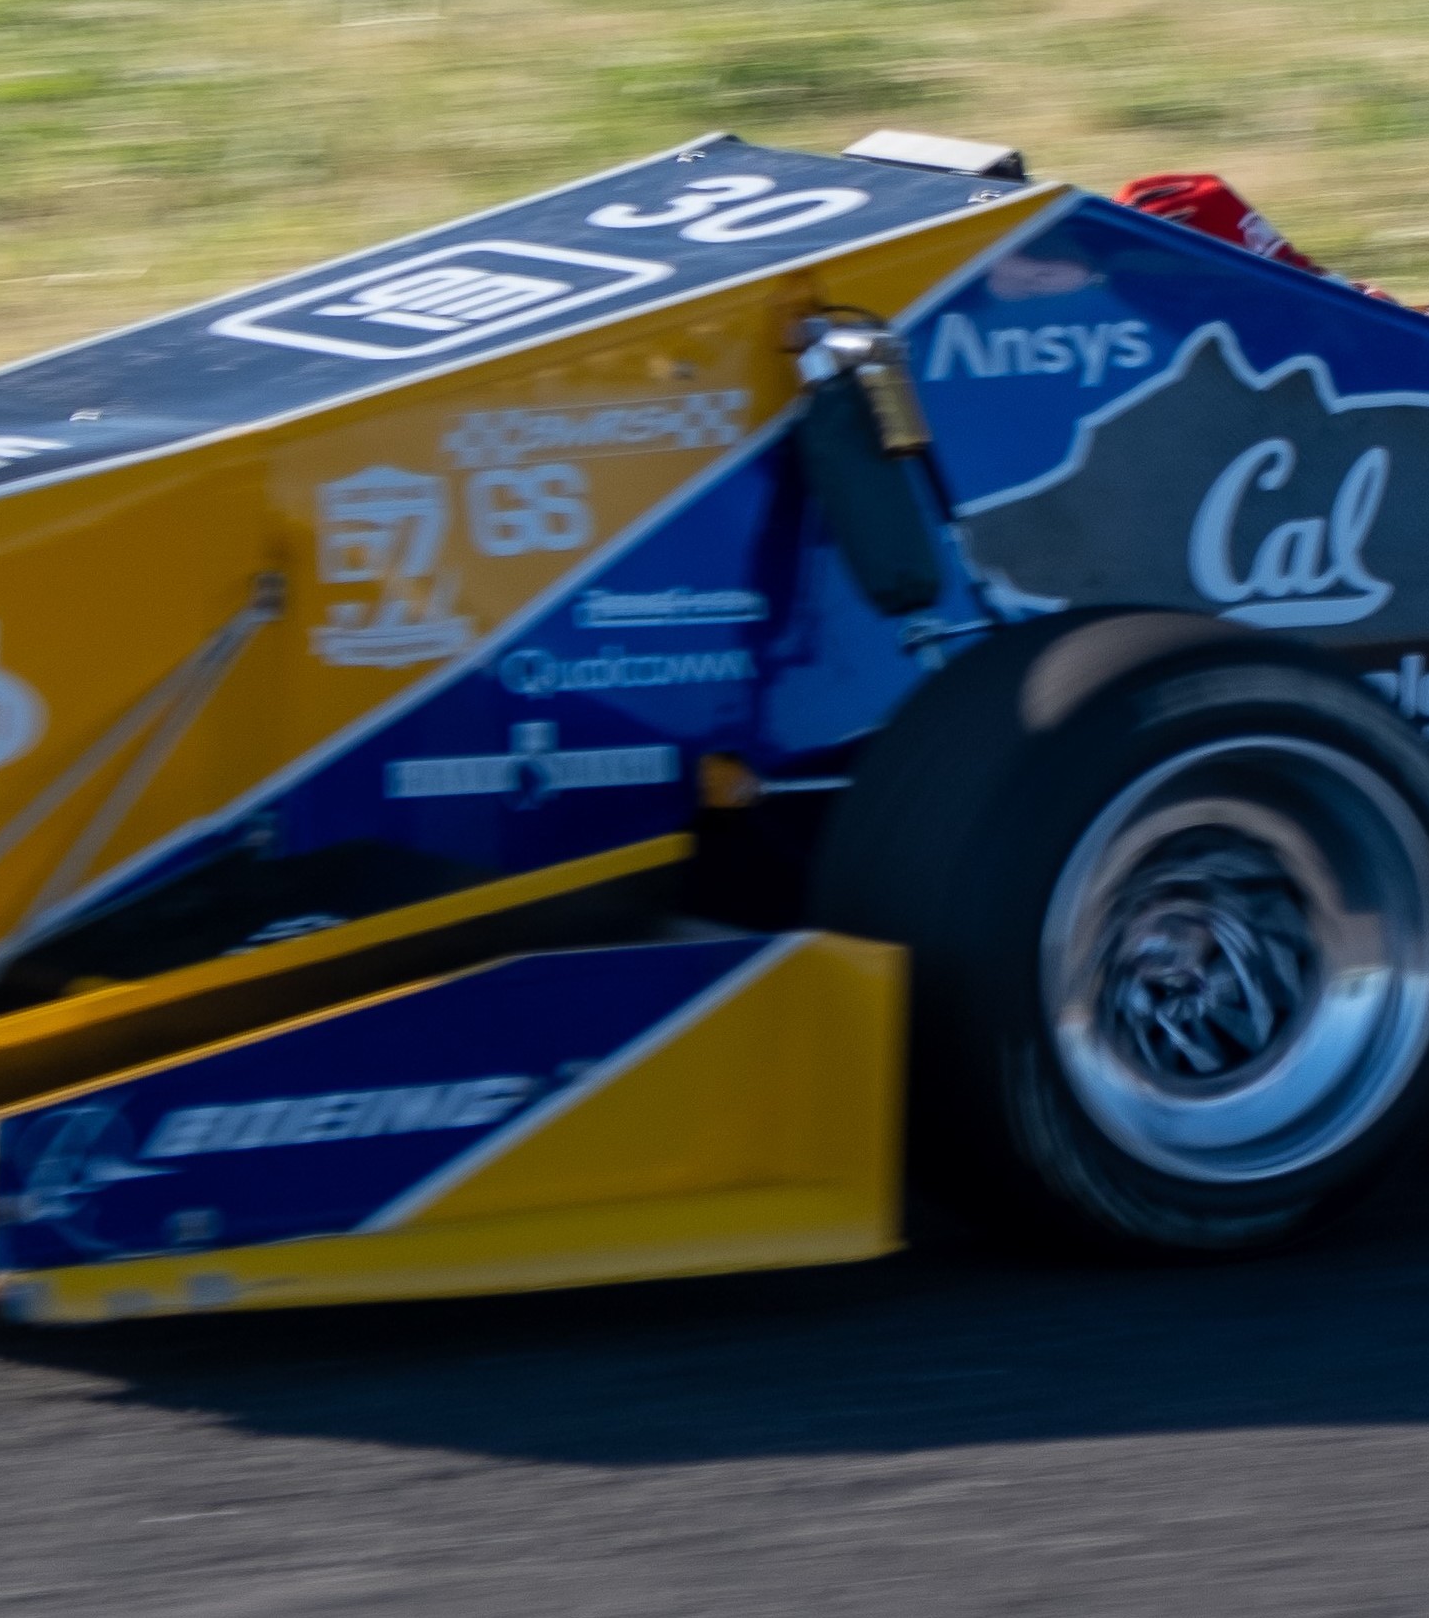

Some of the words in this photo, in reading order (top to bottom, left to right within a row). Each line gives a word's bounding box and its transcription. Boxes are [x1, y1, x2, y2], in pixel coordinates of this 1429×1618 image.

[584, 173, 871, 243] 30
[312, 267, 572, 331] gm
[925, 312, 1155, 386] Ansys
[1188, 437, 1394, 629] Cal
